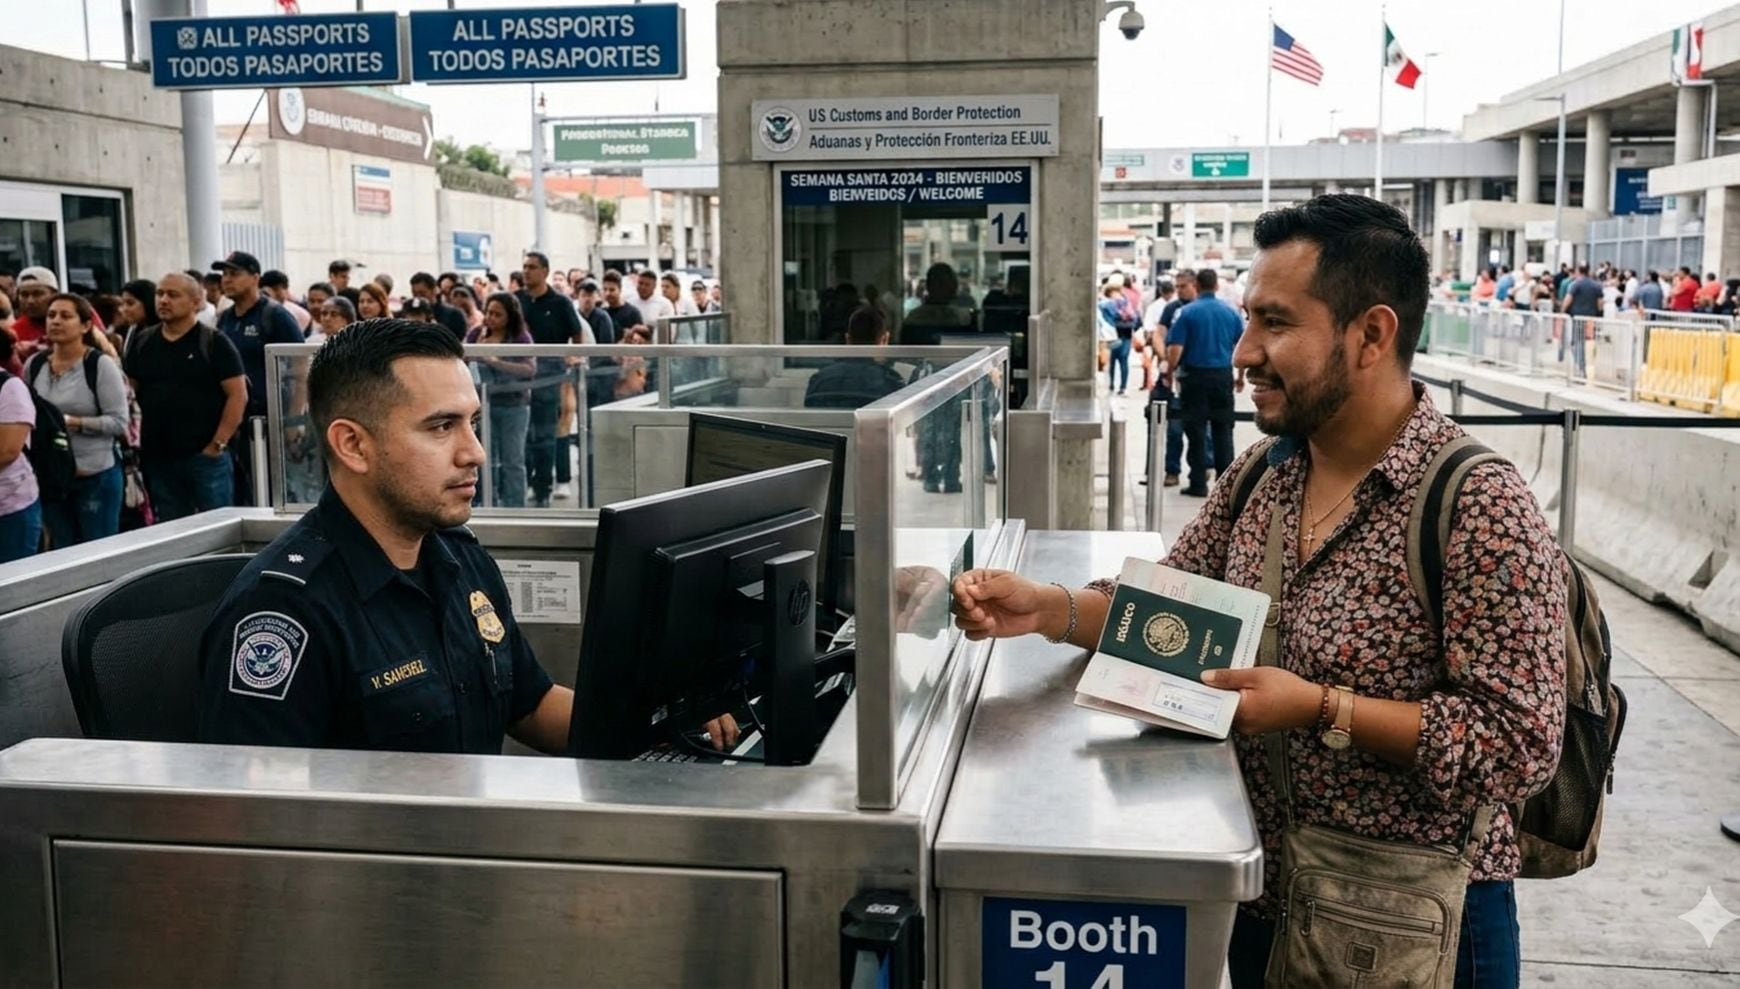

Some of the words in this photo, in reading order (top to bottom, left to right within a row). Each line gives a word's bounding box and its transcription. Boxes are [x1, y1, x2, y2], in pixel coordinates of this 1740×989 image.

[202, 27, 241, 49] ALL
[246, 23, 370, 46] PASSPORTS
[453, 20, 495, 41] ALL
[502, 14, 635, 40] PASSPORTS
[168, 57, 240, 78] TODOS
[245, 52, 383, 76] PASAPORTES
[429, 50, 505, 71] TODOS
[512, 45, 661, 70] PASAPORTES
[809, 108, 826, 122] US
[830, 107, 882, 122] Customs
[886, 107, 908, 121] and
[912, 106, 953, 120] Border
[957, 105, 1021, 120] Protection
[809, 134, 862, 149] Aduanas
[865, 136, 872, 151] y
[875, 132, 941, 148] Protección
[945, 132, 1007, 146] Fronteriza
[1011, 130, 1052, 145] EE.UU.
[790, 173, 845, 187] SEMANA
[847, 172, 888, 186] SANTA
[908, 187, 917, 203] /
[919, 186, 984, 200] WELCOME
[991, 211, 1028, 245] 14
[1009, 909, 1158, 955] Booth
